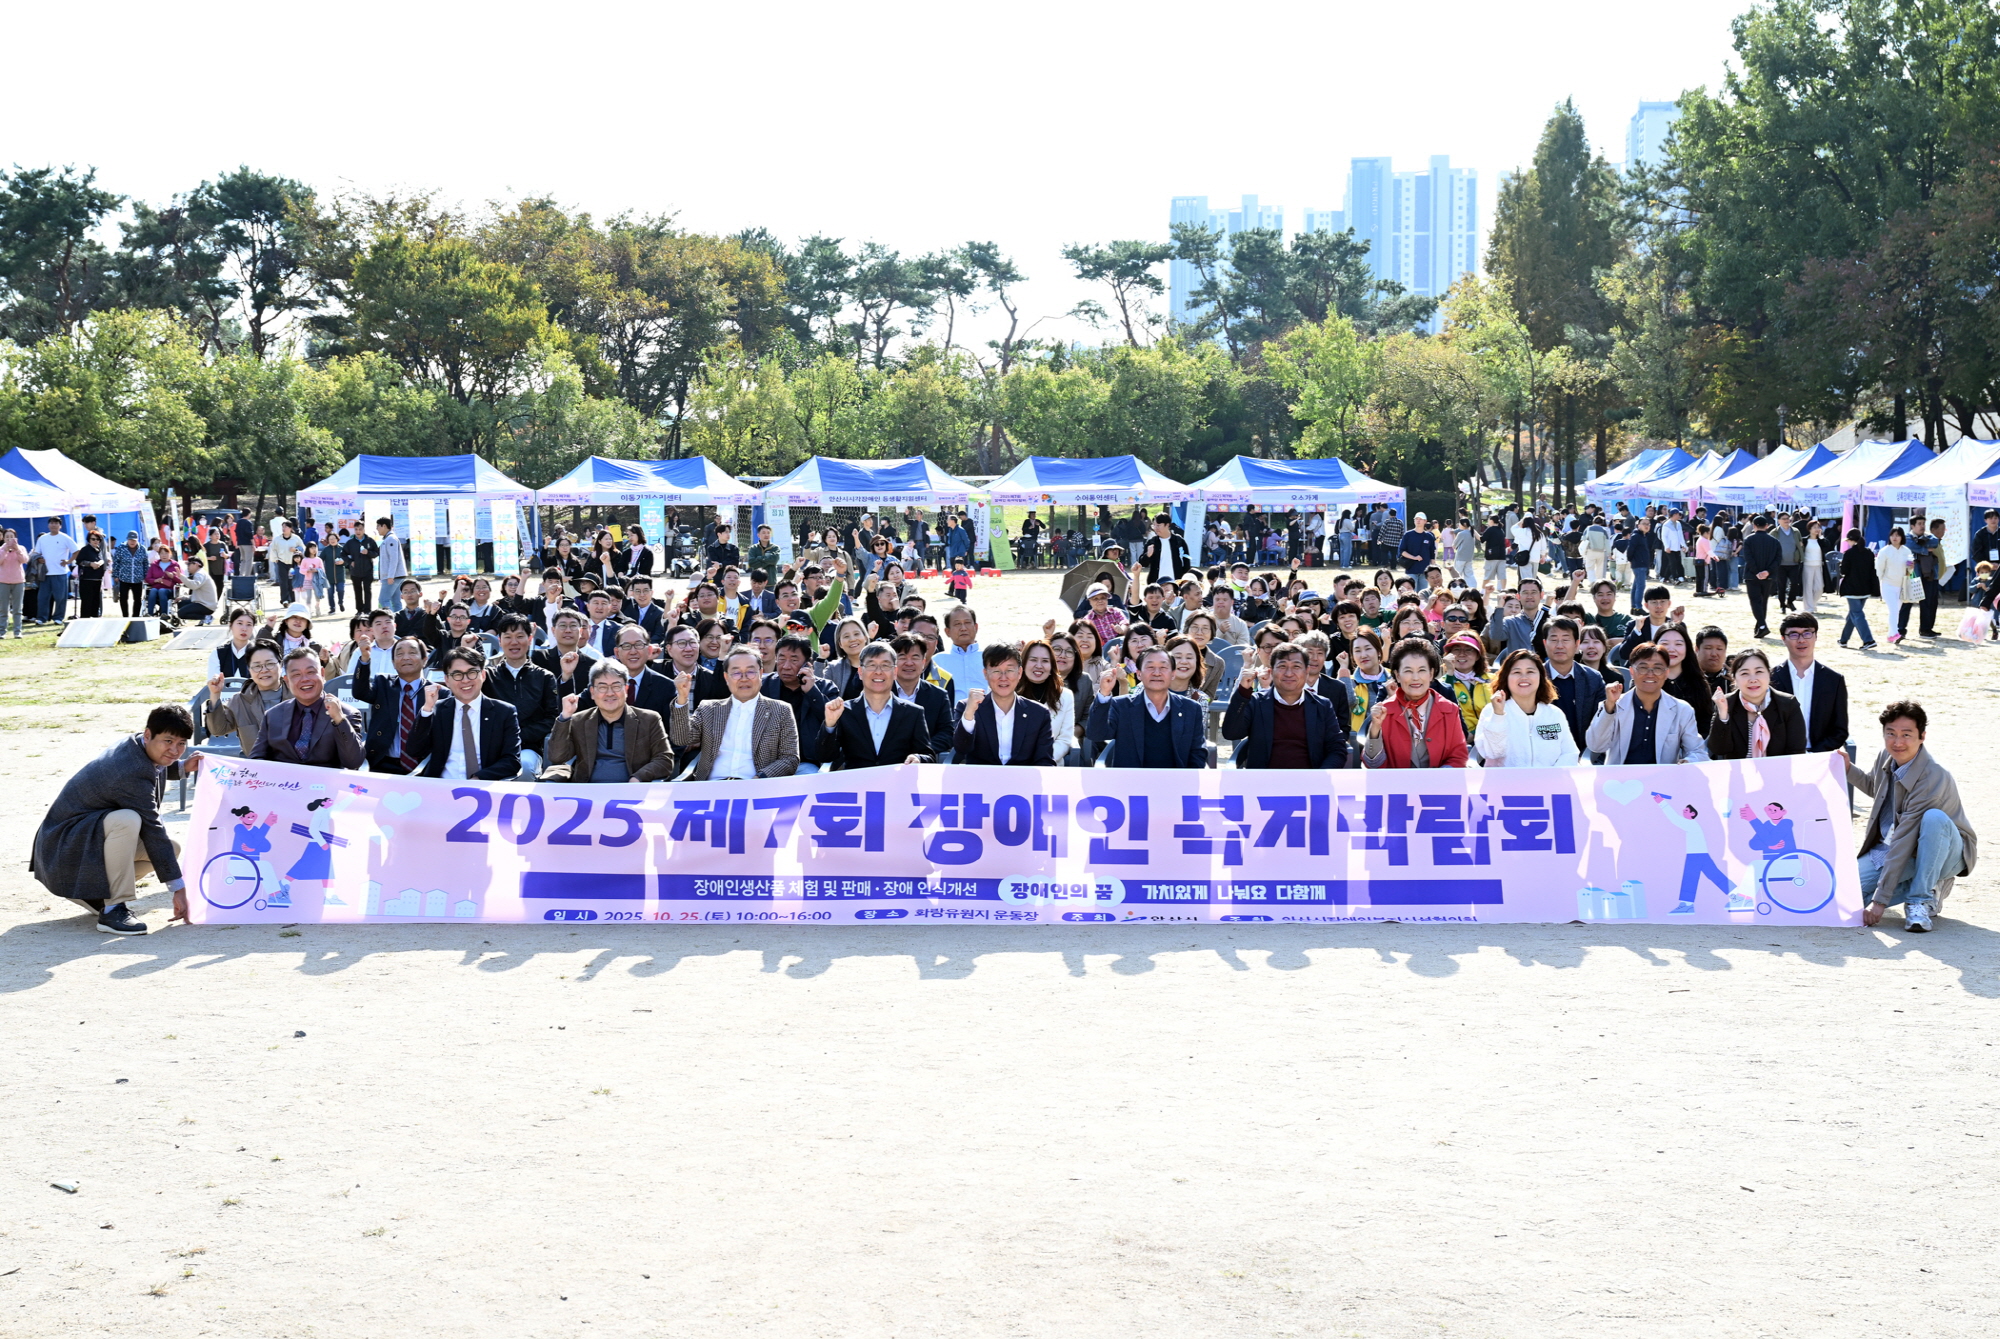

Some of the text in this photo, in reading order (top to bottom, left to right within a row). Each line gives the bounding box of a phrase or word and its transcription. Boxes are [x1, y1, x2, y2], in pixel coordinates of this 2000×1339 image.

[278, 781, 302, 791] 안산
[445, 787, 1576, 867] 2025 제7회 장애인 복지박람회
[694, 879, 978, 897] 장애인생산품 체험 및 판매 장애 인식개선
[1010, 882, 1114, 900] 장애인의 꿈
[1142, 884, 1326, 900] 가치있게 나눠요 다함께
[736, 911, 832, 921] 10:00~16:00
[914, 908, 1039, 922] 화랑유원지 운동장
